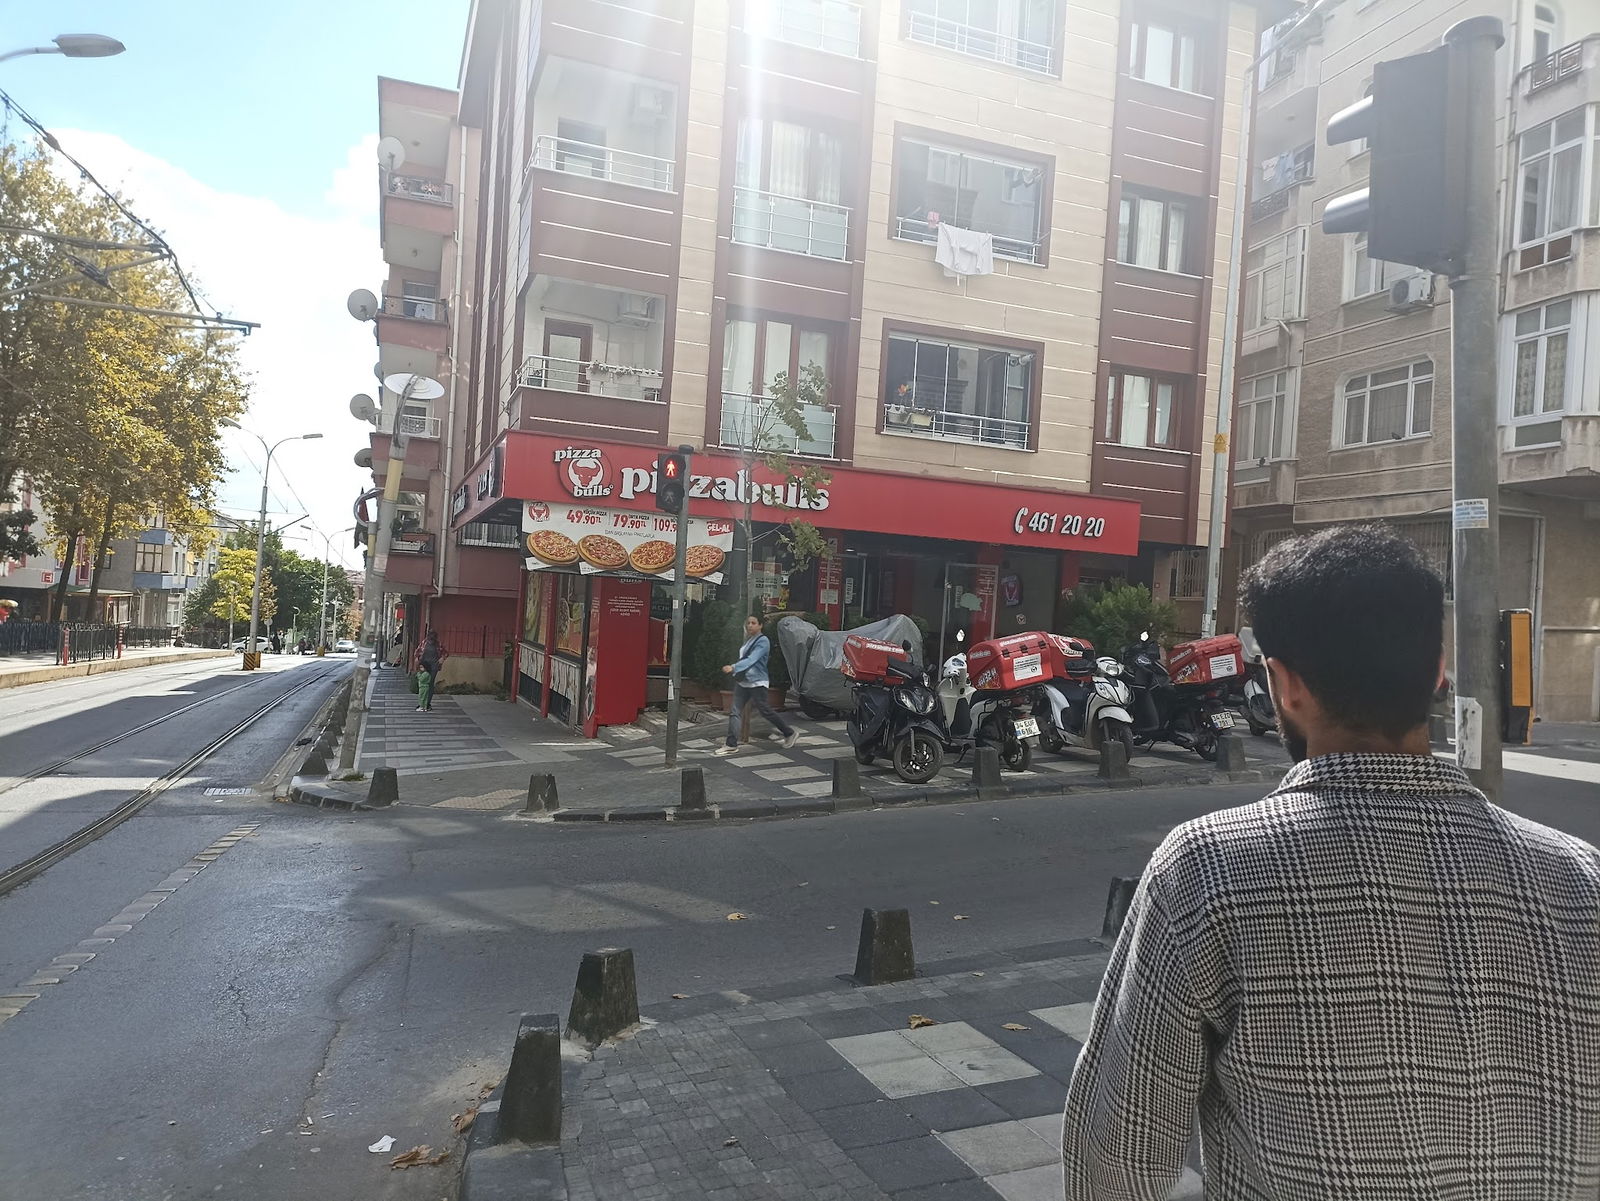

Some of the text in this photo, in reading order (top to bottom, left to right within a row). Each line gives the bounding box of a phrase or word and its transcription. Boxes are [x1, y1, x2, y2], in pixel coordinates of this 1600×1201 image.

[554, 446, 602, 462] pizza
[1028, 511, 1105, 538] 461 20 20
